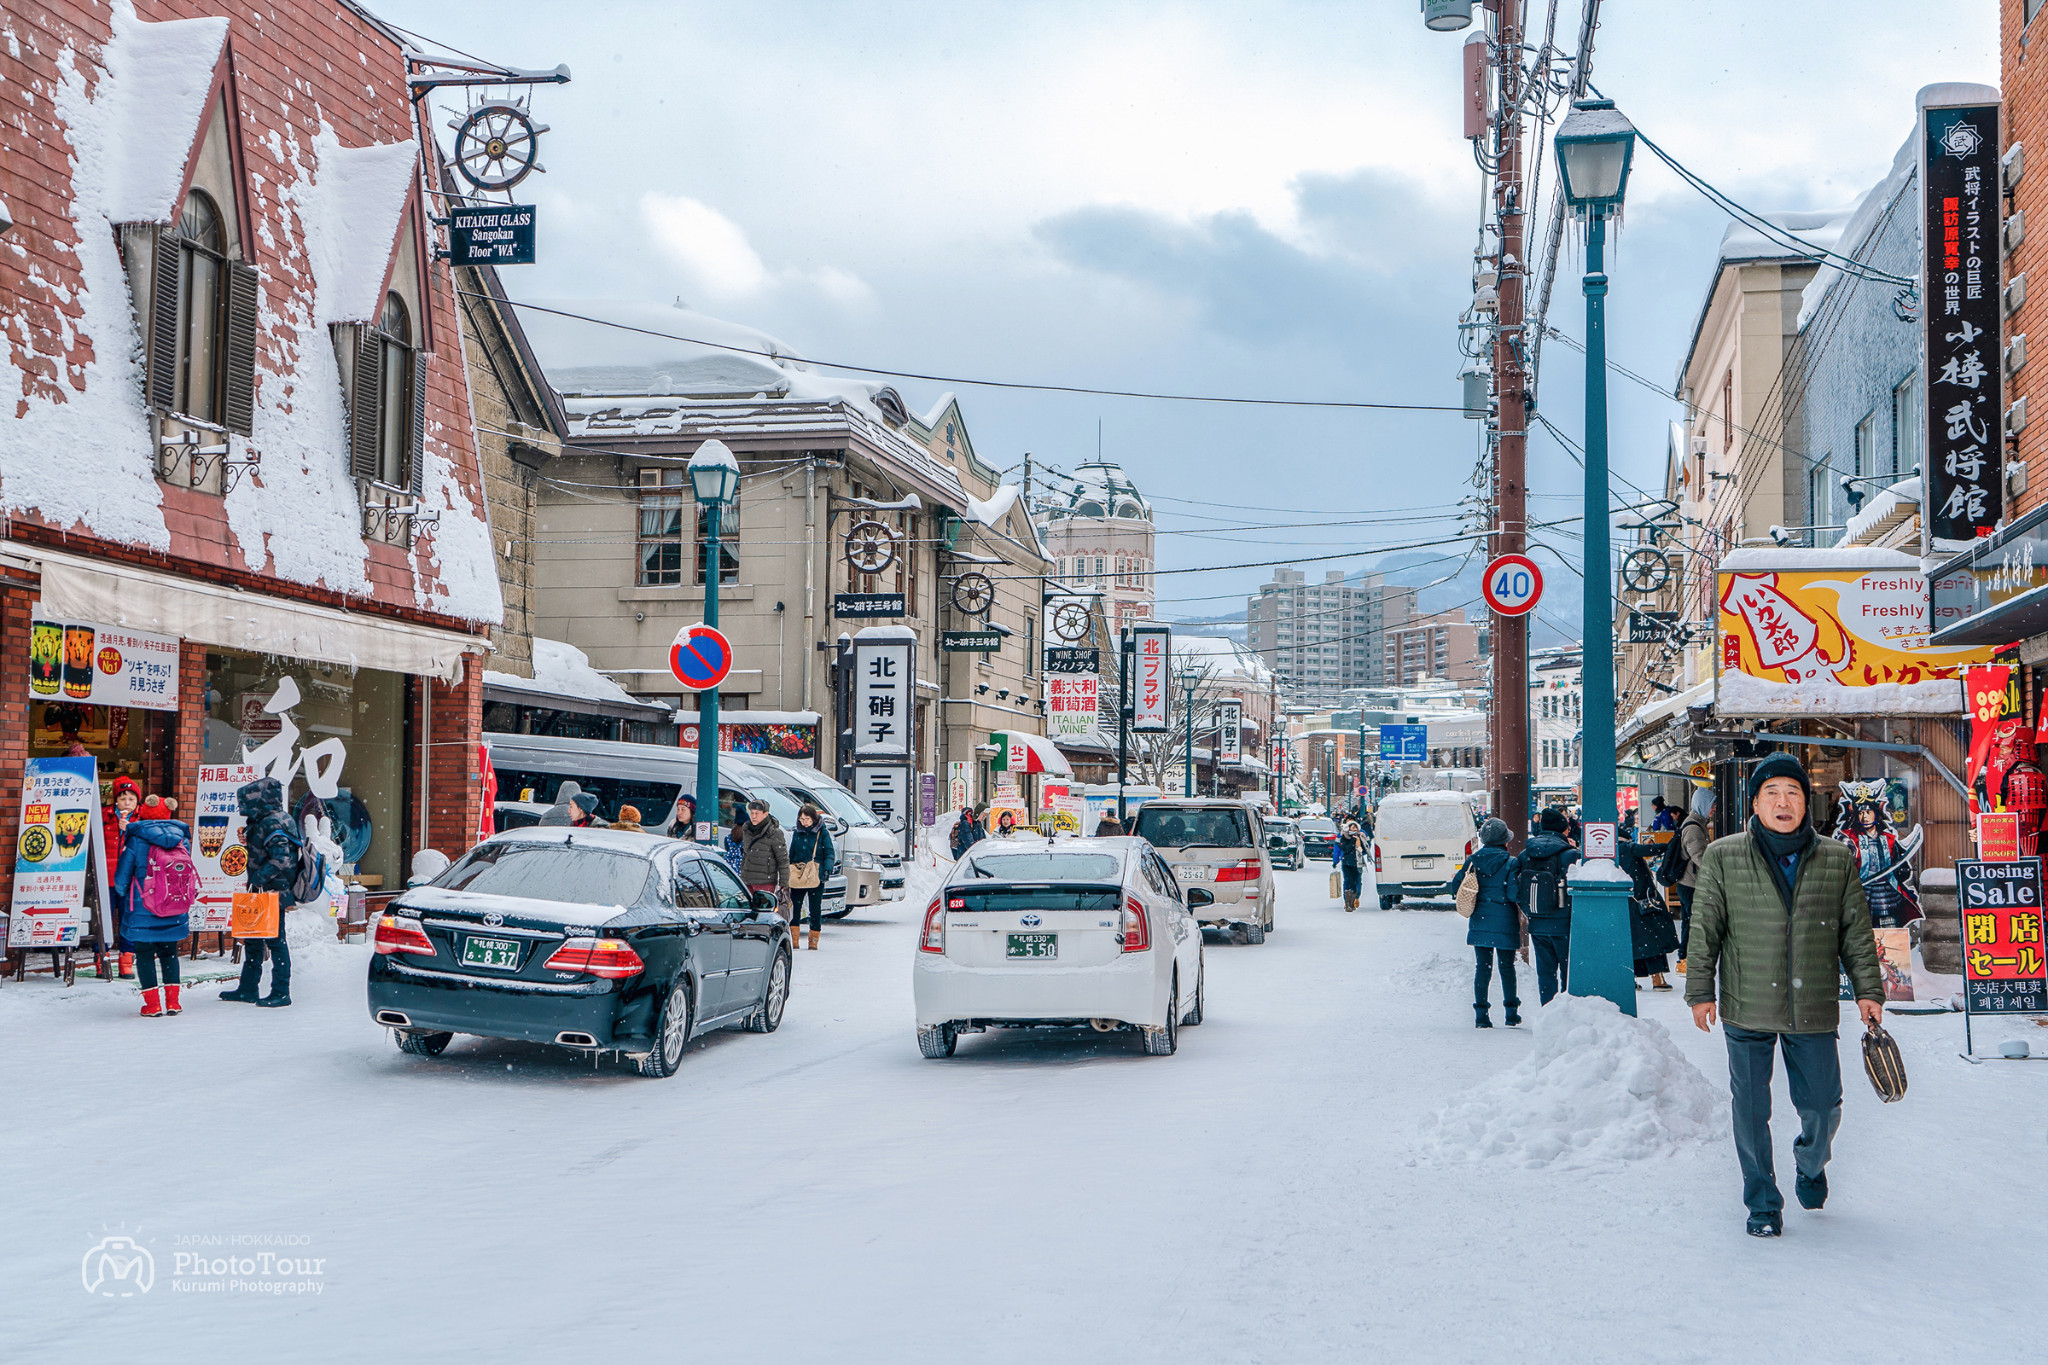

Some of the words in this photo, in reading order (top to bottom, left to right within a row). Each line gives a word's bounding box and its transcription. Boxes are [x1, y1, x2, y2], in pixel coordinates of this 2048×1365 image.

[455, 215, 499, 228] KITAICHI
[500, 213, 531, 226] GLASS
[472, 227, 514, 243] Sangokan
[1964, 166, 1982, 299] 武将イラストの巨匠
[468, 245, 492, 258] Floor
[1932, 320, 1988, 522] 小樽武将館
[1495, 571, 1530, 598] 40
[1862, 578, 1924, 593] Freshly
[836, 600, 903, 612] 北一硝子三号館
[1862, 604, 1924, 619] Freshly
[1743, 589, 1799, 656] いか太郎
[945, 637, 999, 646] 北一硝子三号館
[1055, 650, 1072, 659] WINE
[1074, 650, 1092, 659] SHOP
[102, 661, 118, 674] No.1
[1051, 660, 1095, 671] ヴィノテカ
[1143, 639, 1160, 709] 北一プラザ
[129, 676, 166, 694] 月見うさぎ
[1050, 679, 1097, 695] 義大利
[868, 656, 896, 743] 北一硝子
[1050, 696, 1097, 712] 葡萄酒
[1052, 715, 1094, 725] ITALIAN
[1059, 725, 1088, 734] WINE
[1224, 707, 1237, 751] 北一硝子
[1011, 745, 1024, 762] 北一
[200, 767, 229, 782] 和風
[229, 774, 259, 783] GLASS
[44, 787, 92, 797] 万華鏡グラス
[200, 792, 235, 801] 小樽切子
[868, 774, 894, 822] 三号
[28, 805, 49, 813] NEW
[25, 814, 50, 823] 新商品
[1965, 864, 2035, 879] Closing
[1967, 881, 2035, 906] Sale
[951, 899, 964, 908] 520
[1967, 946, 2044, 976] セール
[1971, 980, 2042, 995] 关店大甩卖
[1978, 996, 2005, 1010] 폐점
[2009, 995, 2037, 1009] 세일
